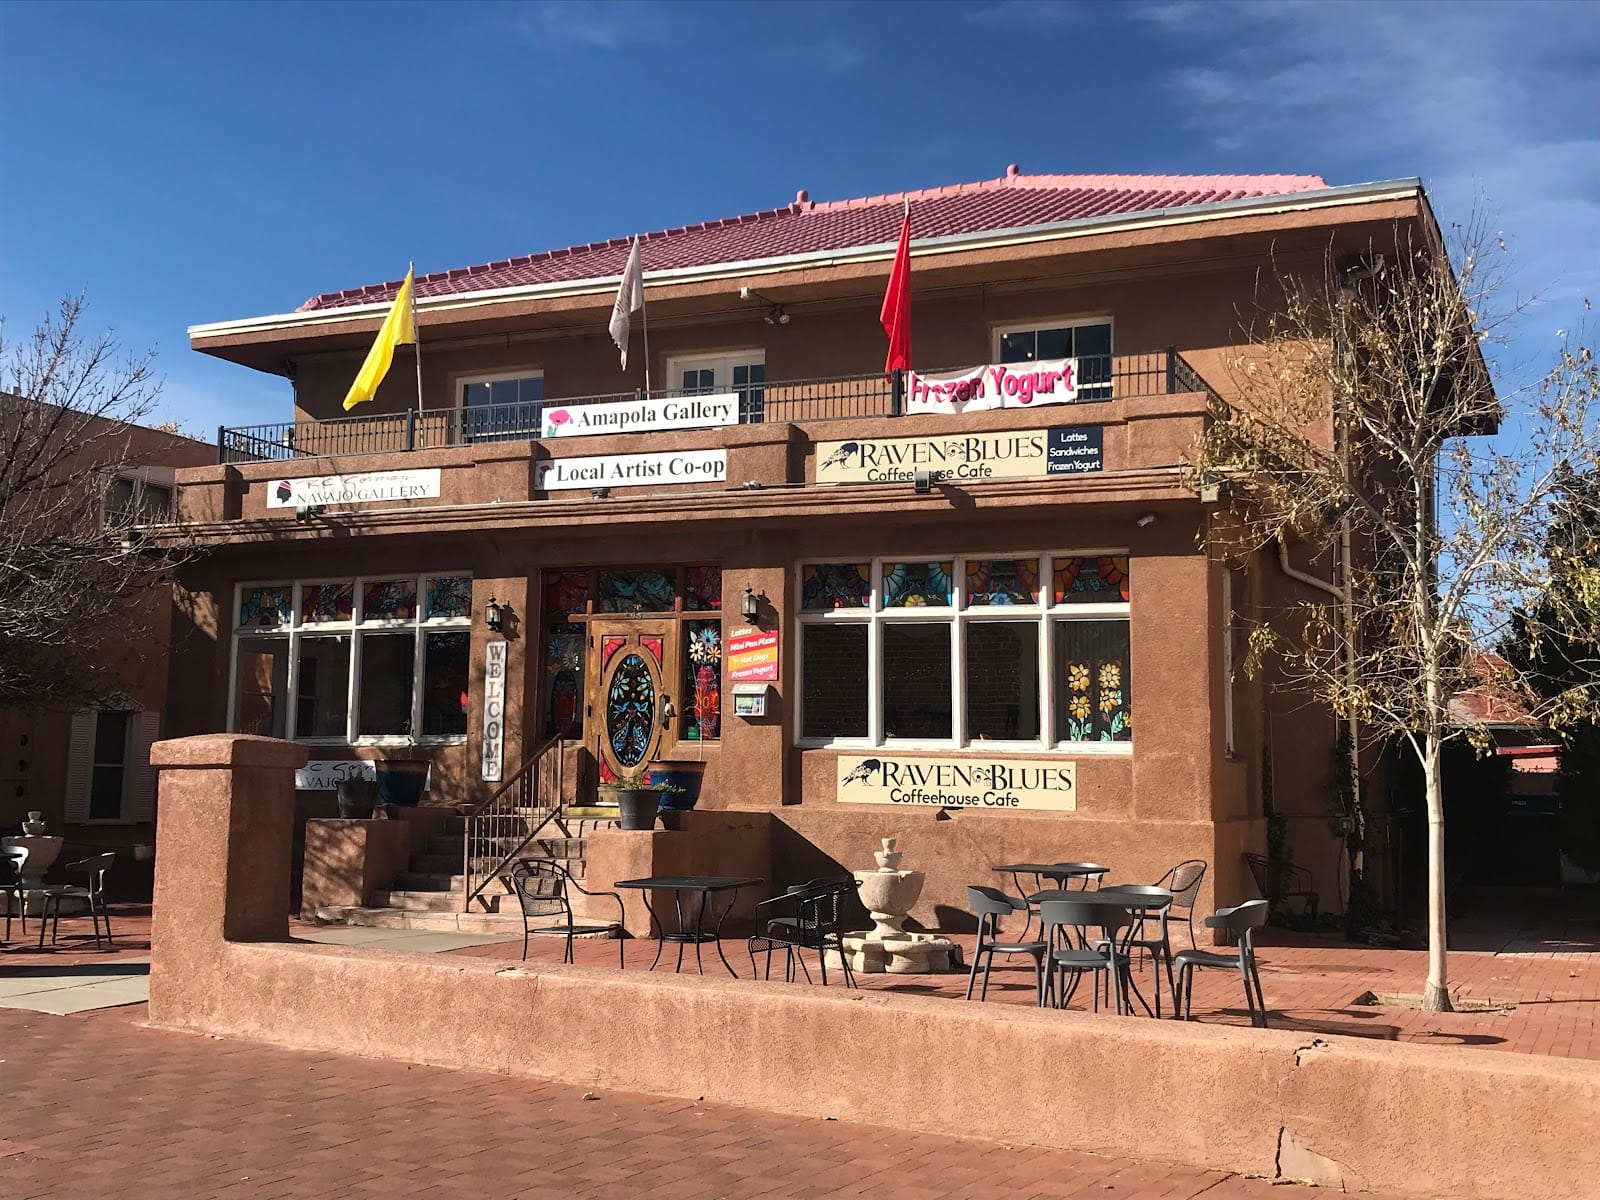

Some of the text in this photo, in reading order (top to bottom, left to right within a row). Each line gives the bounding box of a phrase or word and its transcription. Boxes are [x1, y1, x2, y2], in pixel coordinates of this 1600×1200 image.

[909, 363, 1075, 404] Frozen Yogurt
[577, 402, 732, 428] Amapola Gallery
[1061, 433, 1088, 442] Lattes
[860, 437, 1043, 468] RAVEN BLUES
[1050, 445, 1098, 457] Sandwiches
[557, 458, 724, 481] Local Artist Co-op
[957, 463, 992, 478] Cafe
[1048, 460, 1100, 472] Frozen Yogurt
[297, 485, 430, 503] NAVAJO GALLERY
[731, 628, 752, 637] Lattes
[486, 646, 504, 776] WELCOME
[882, 762, 1072, 791] RAVEN BLUES
[890, 788, 1020, 807] Coffeehouse Cafe
